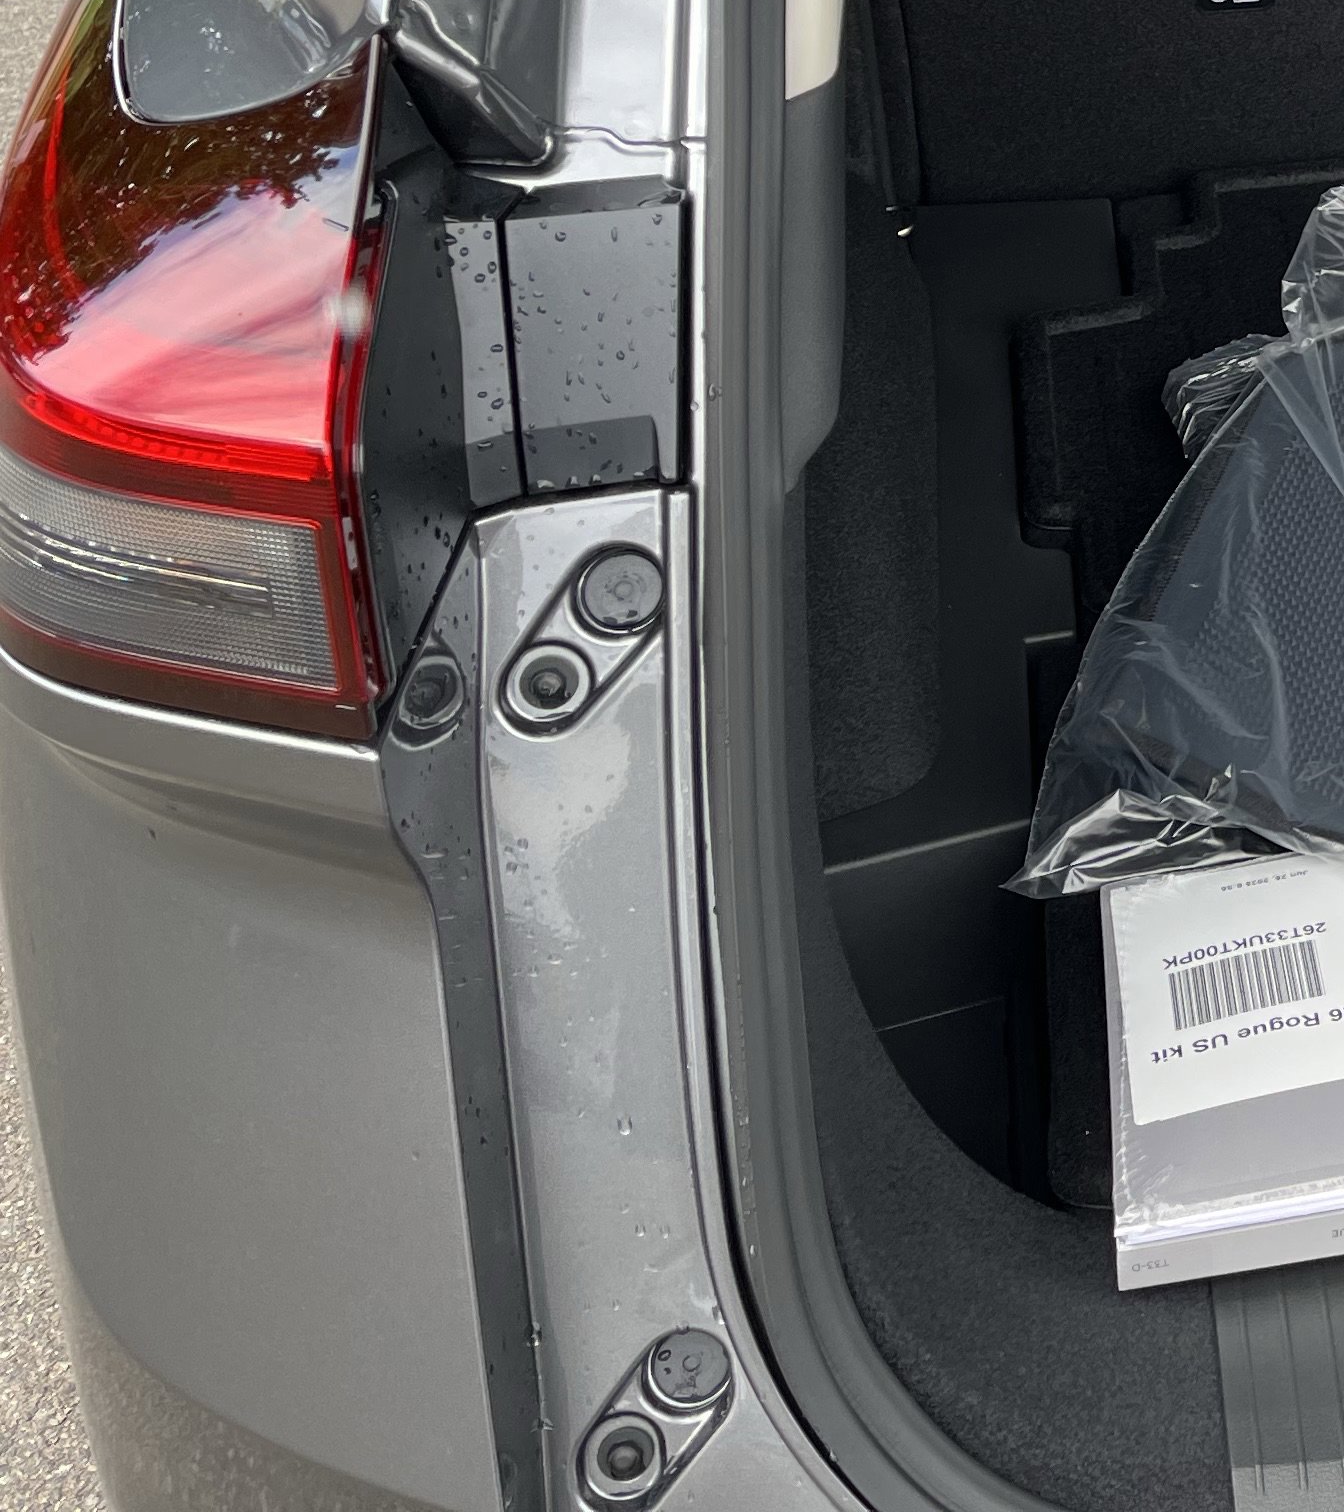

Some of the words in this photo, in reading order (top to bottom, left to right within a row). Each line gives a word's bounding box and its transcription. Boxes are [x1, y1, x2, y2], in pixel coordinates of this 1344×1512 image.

[1162, 921, 1327, 970] 26T33UKT00PK
[1237, 1012, 1321, 1038] Rogue
[1192, 1033, 1229, 1054] US
[1150, 1044, 1184, 1065] kit
[1131, 1258, 1170, 1273] T33-D
